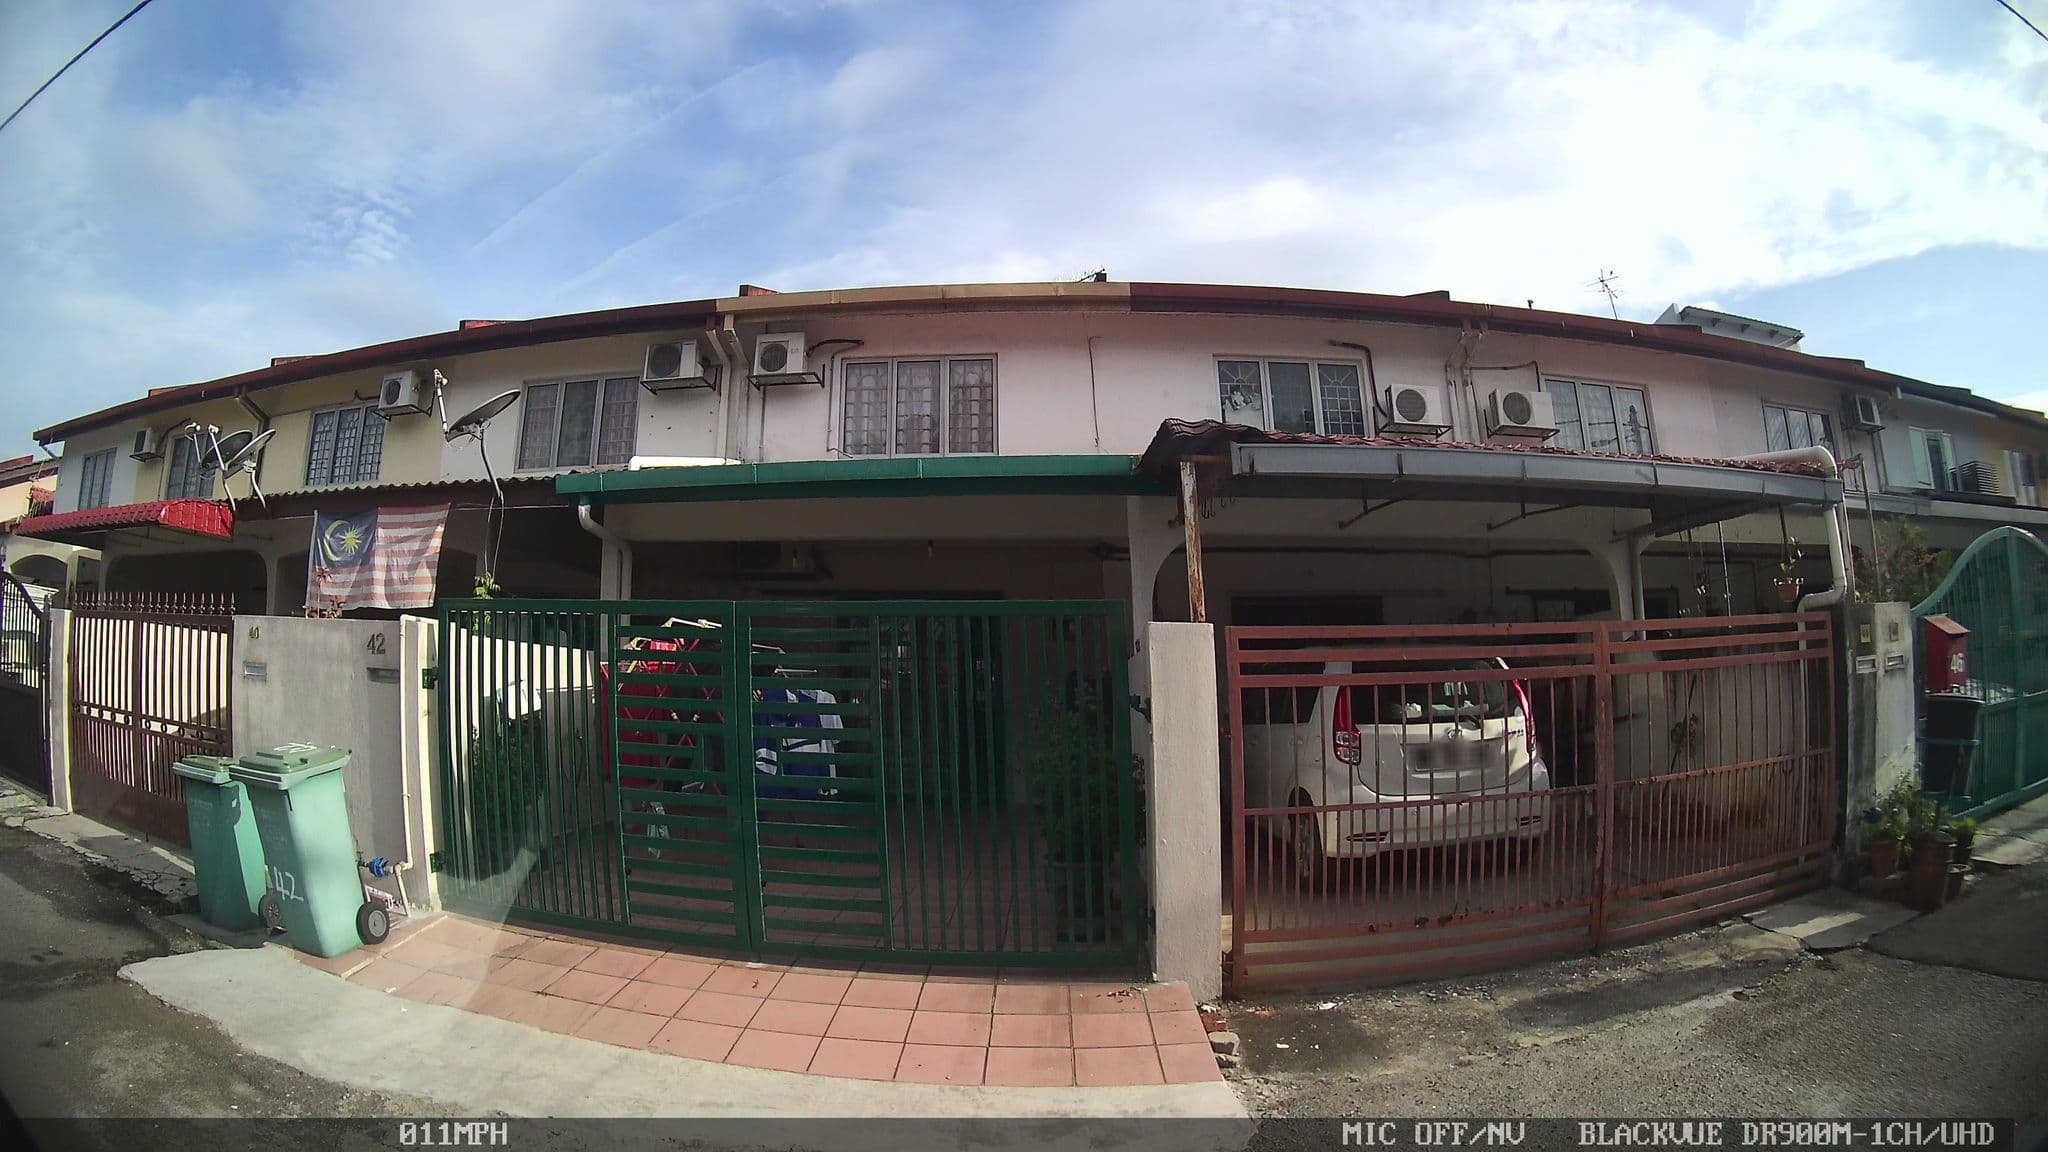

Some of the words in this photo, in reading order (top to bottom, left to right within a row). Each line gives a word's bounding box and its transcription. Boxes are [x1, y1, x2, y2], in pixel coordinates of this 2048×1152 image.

[366, 632, 386, 655] 42
[1950, 652, 1966, 674] 46
[273, 865, 305, 902] 42
